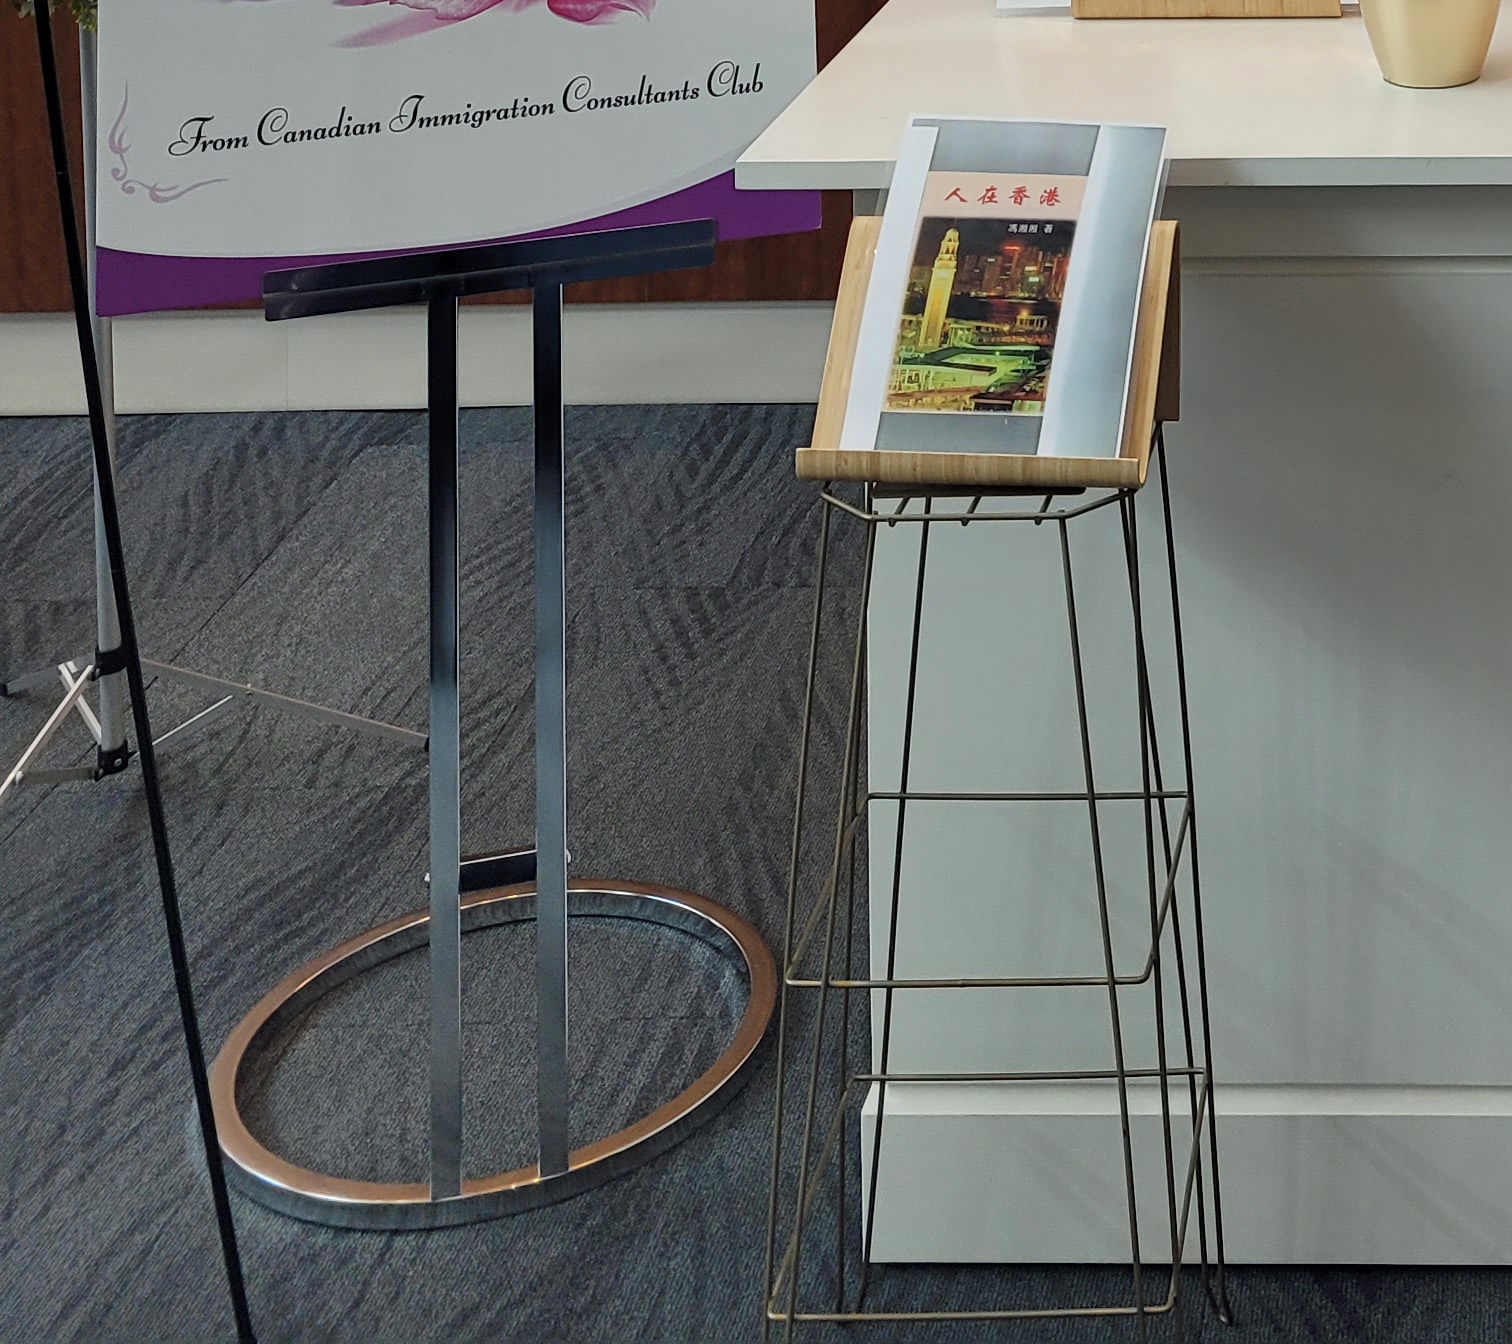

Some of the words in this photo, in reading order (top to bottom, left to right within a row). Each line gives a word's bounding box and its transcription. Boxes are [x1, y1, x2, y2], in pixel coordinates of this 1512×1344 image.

[167, 116, 250, 158] From
[256, 107, 383, 148] Canadian
[388, 94, 555, 134] Immigration
[562, 76, 701, 116] Consultants
[706, 60, 765, 99] Club
[943, 185, 1062, 207] 人在香港
